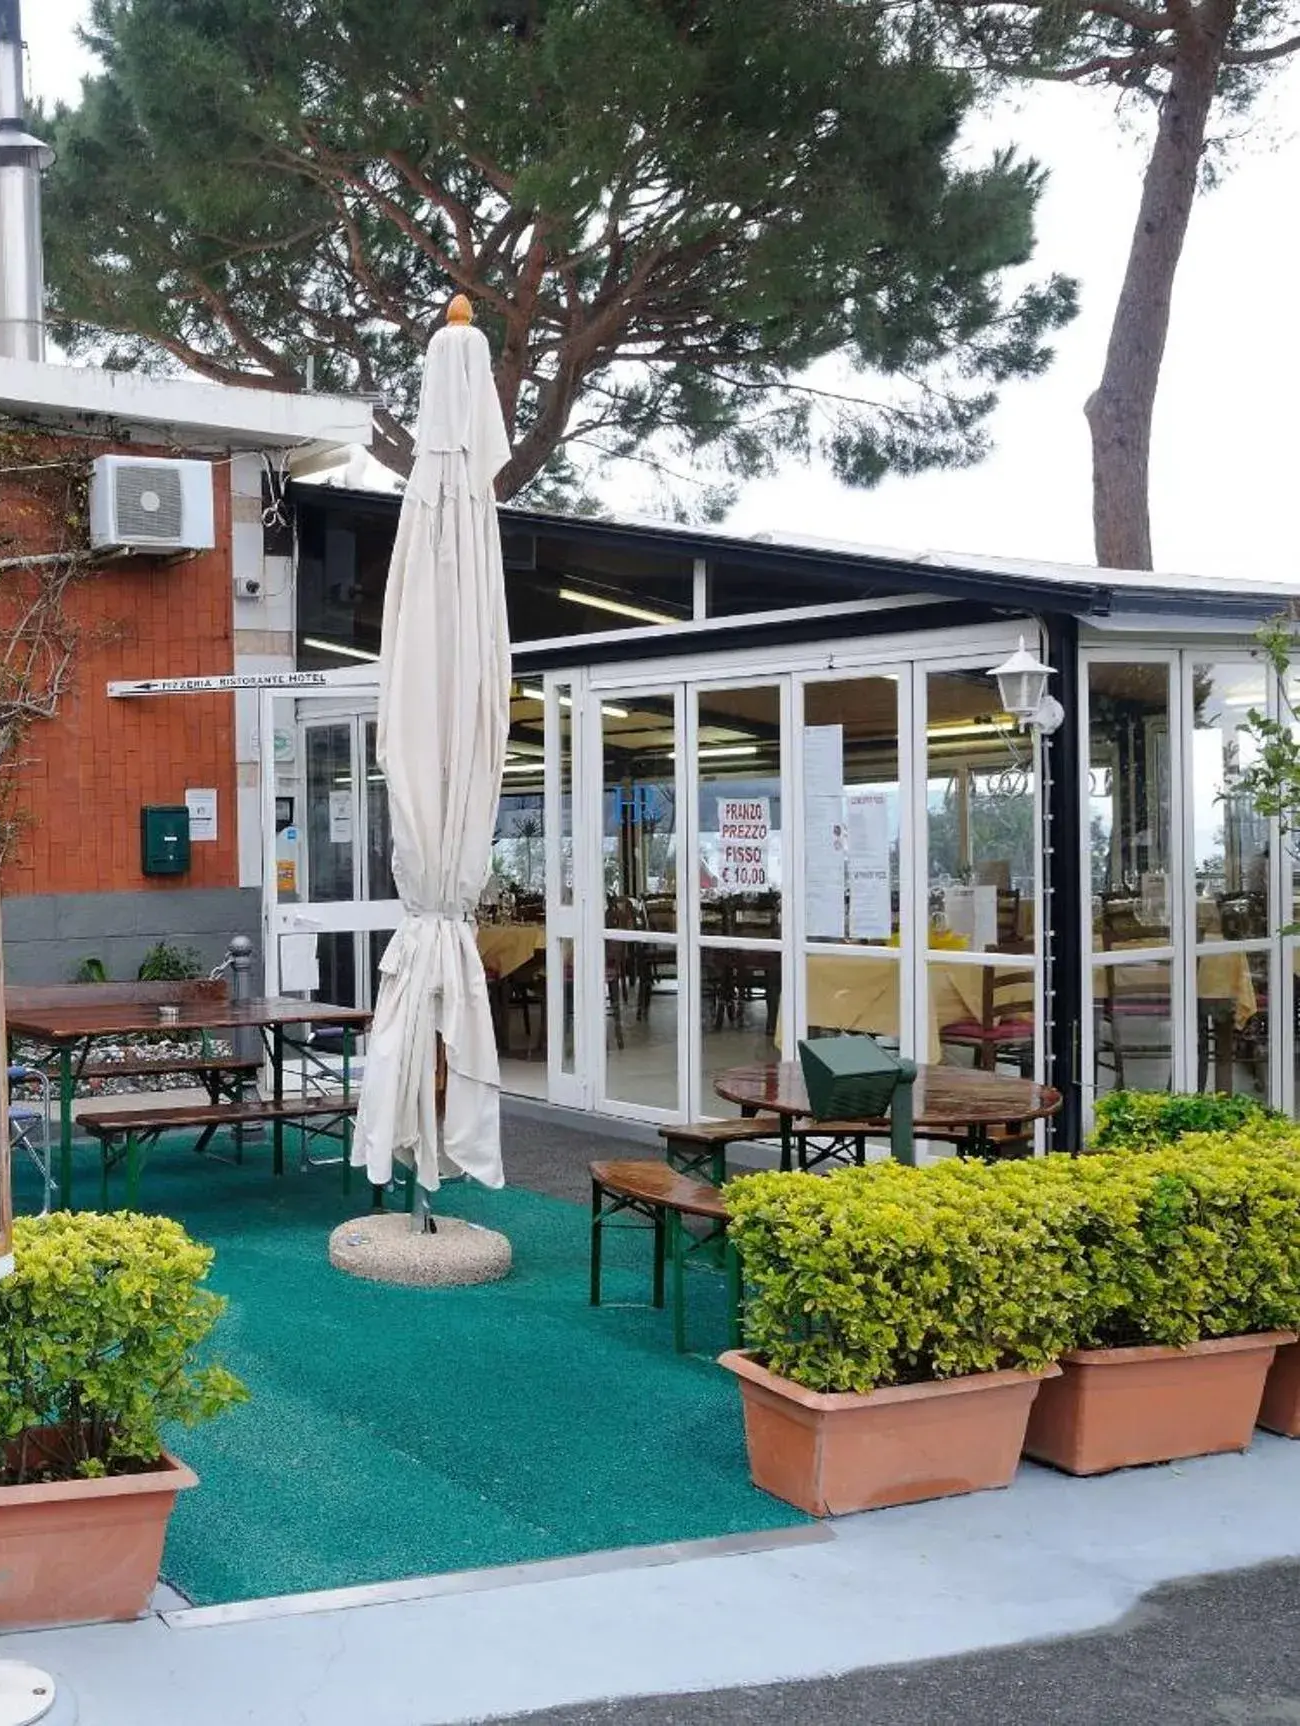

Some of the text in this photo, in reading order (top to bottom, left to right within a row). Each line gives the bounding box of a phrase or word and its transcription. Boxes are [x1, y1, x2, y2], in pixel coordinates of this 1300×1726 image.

[162, 673, 326, 689] PIZZERIA RISTORANTE HOTEL
[722, 824, 767, 840] PREZZO
[725, 846, 762, 863] FISSO
